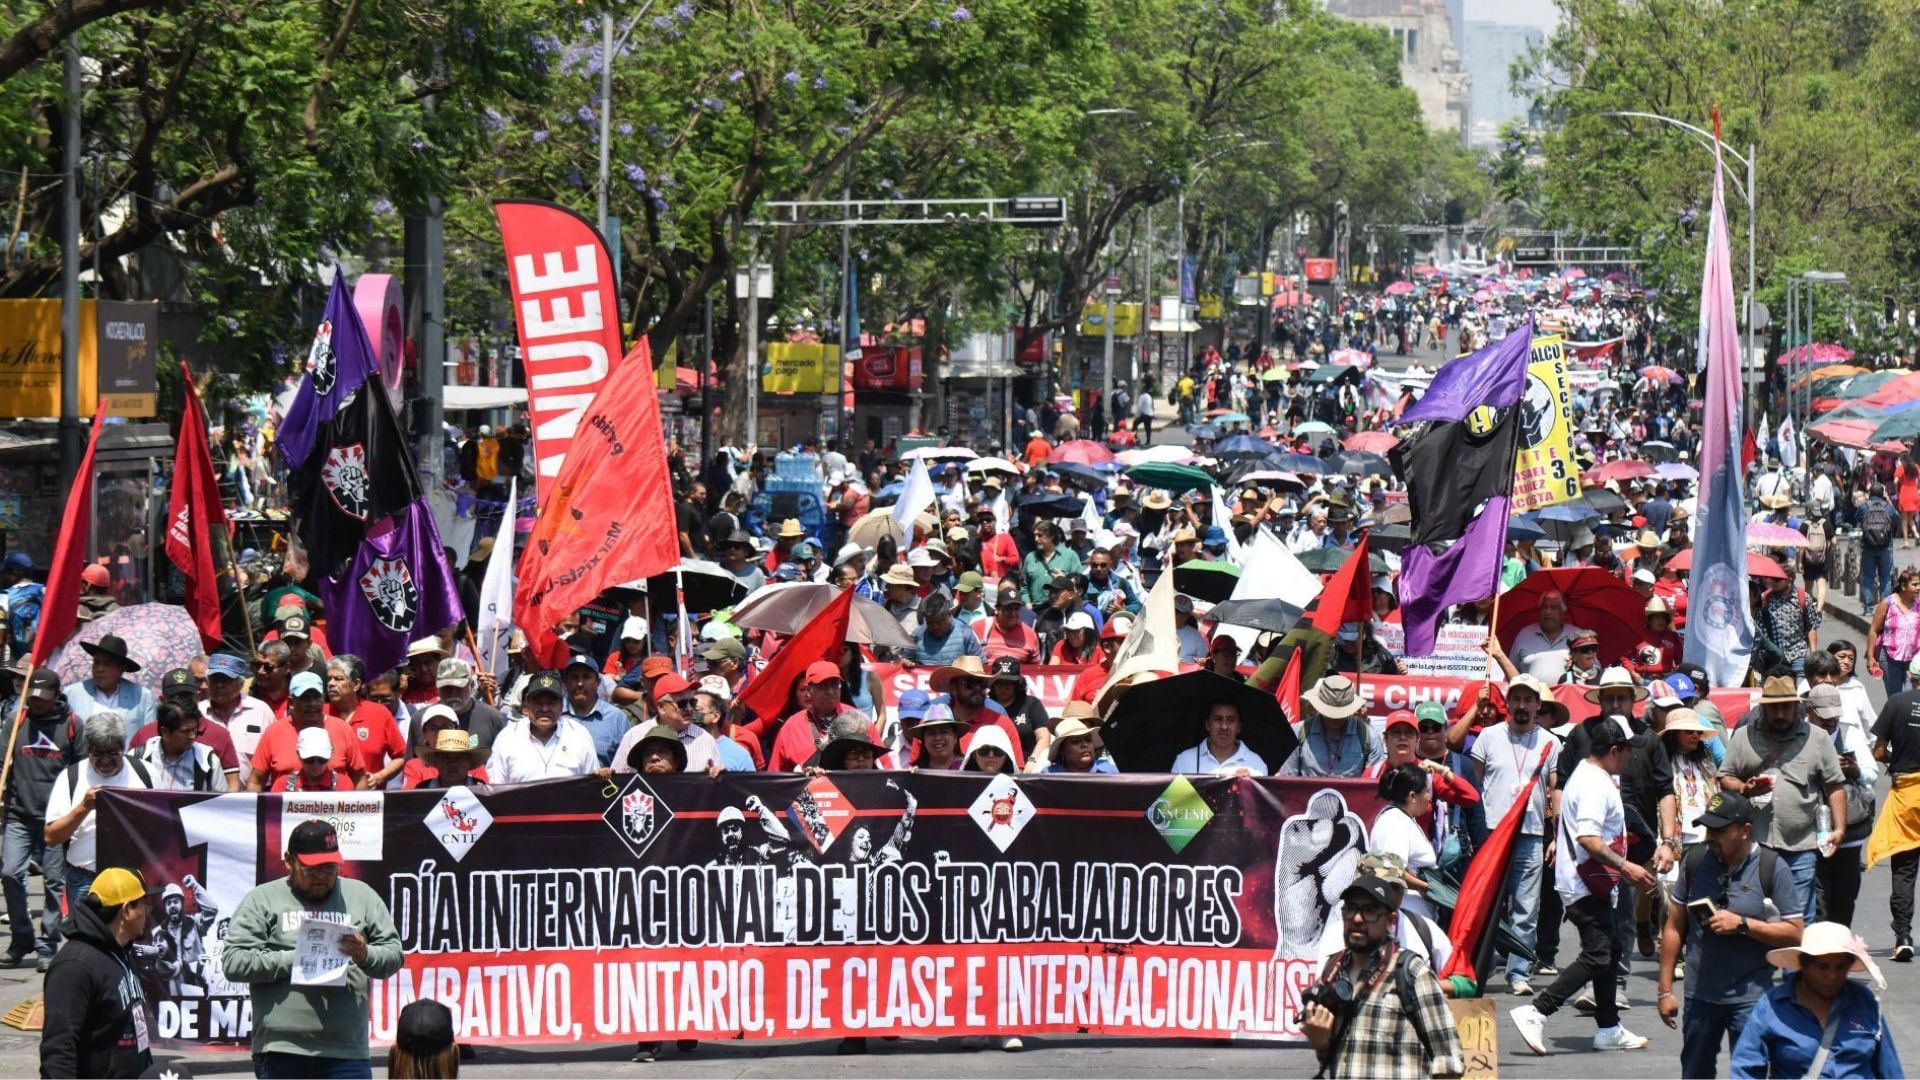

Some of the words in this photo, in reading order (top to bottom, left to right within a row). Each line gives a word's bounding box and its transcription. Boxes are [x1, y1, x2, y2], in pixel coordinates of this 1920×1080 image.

[513, 243, 610, 478] NUEE
[776, 358, 817, 367] mercado
[1530, 343, 1561, 364] ALCO
[775, 367, 799, 376] pago
[1384, 684, 1460, 711] CHIA
[286, 801, 335, 814] Asamblea
[337, 800, 380, 813] Nacional
[441, 833, 478, 844] CNTE
[390, 858, 463, 953] DÍA
[469, 864, 786, 954] INTERNACIONAL
[796, 863, 847, 946] DE
[851, 862, 931, 946] LOS
[934, 861, 1243, 948] TRABAJADORES
[368, 962, 583, 1041] OMBATIVO,
[593, 958, 775, 1037] UNITARIO,
[786, 957, 829, 1030] DE
[842, 955, 956, 1030] CLASE
[968, 956, 987, 1029] E
[997, 954, 1317, 1036] INTERNACIONALIS
[158, 1000, 199, 1039] DE
[209, 999, 253, 1038] MA
